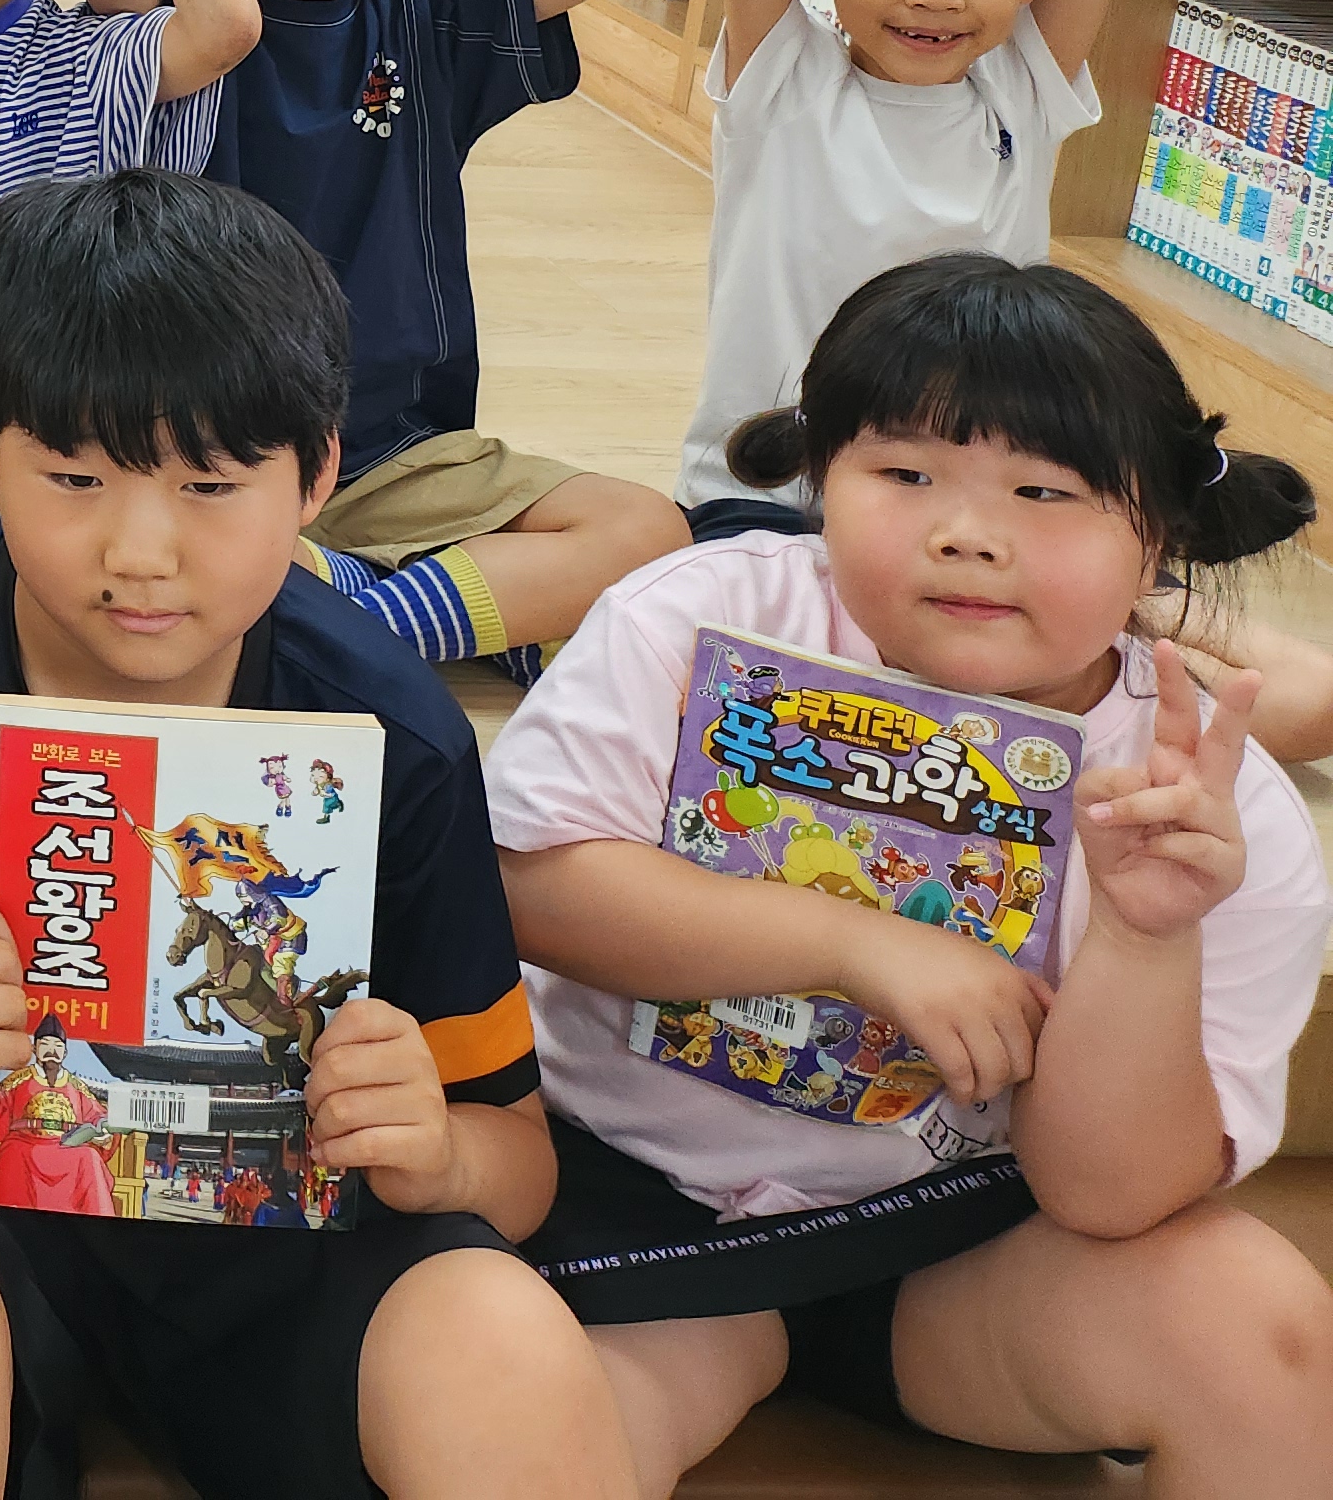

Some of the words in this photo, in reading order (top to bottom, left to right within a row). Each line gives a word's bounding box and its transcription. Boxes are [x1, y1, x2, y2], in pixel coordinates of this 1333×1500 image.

[31, 742, 80, 764] 만화로
[89, 747, 122, 768] 보는
[799, 688, 917, 750] 쿠키런
[713, 699, 833, 790] 폭소
[840, 736, 983, 823] 과학
[970, 800, 1035, 841] 상식
[23, 768, 119, 991] 조선왕조
[26, 996, 110, 1030] 이야기
[558, 1256, 620, 1276] TENNIS
[630, 1243, 700, 1264] PLAYING
[704, 1232, 769, 1252] TENNIS
[777, 1211, 850, 1238] PLAYING
[918, 1171, 990, 1202] PLAYING
